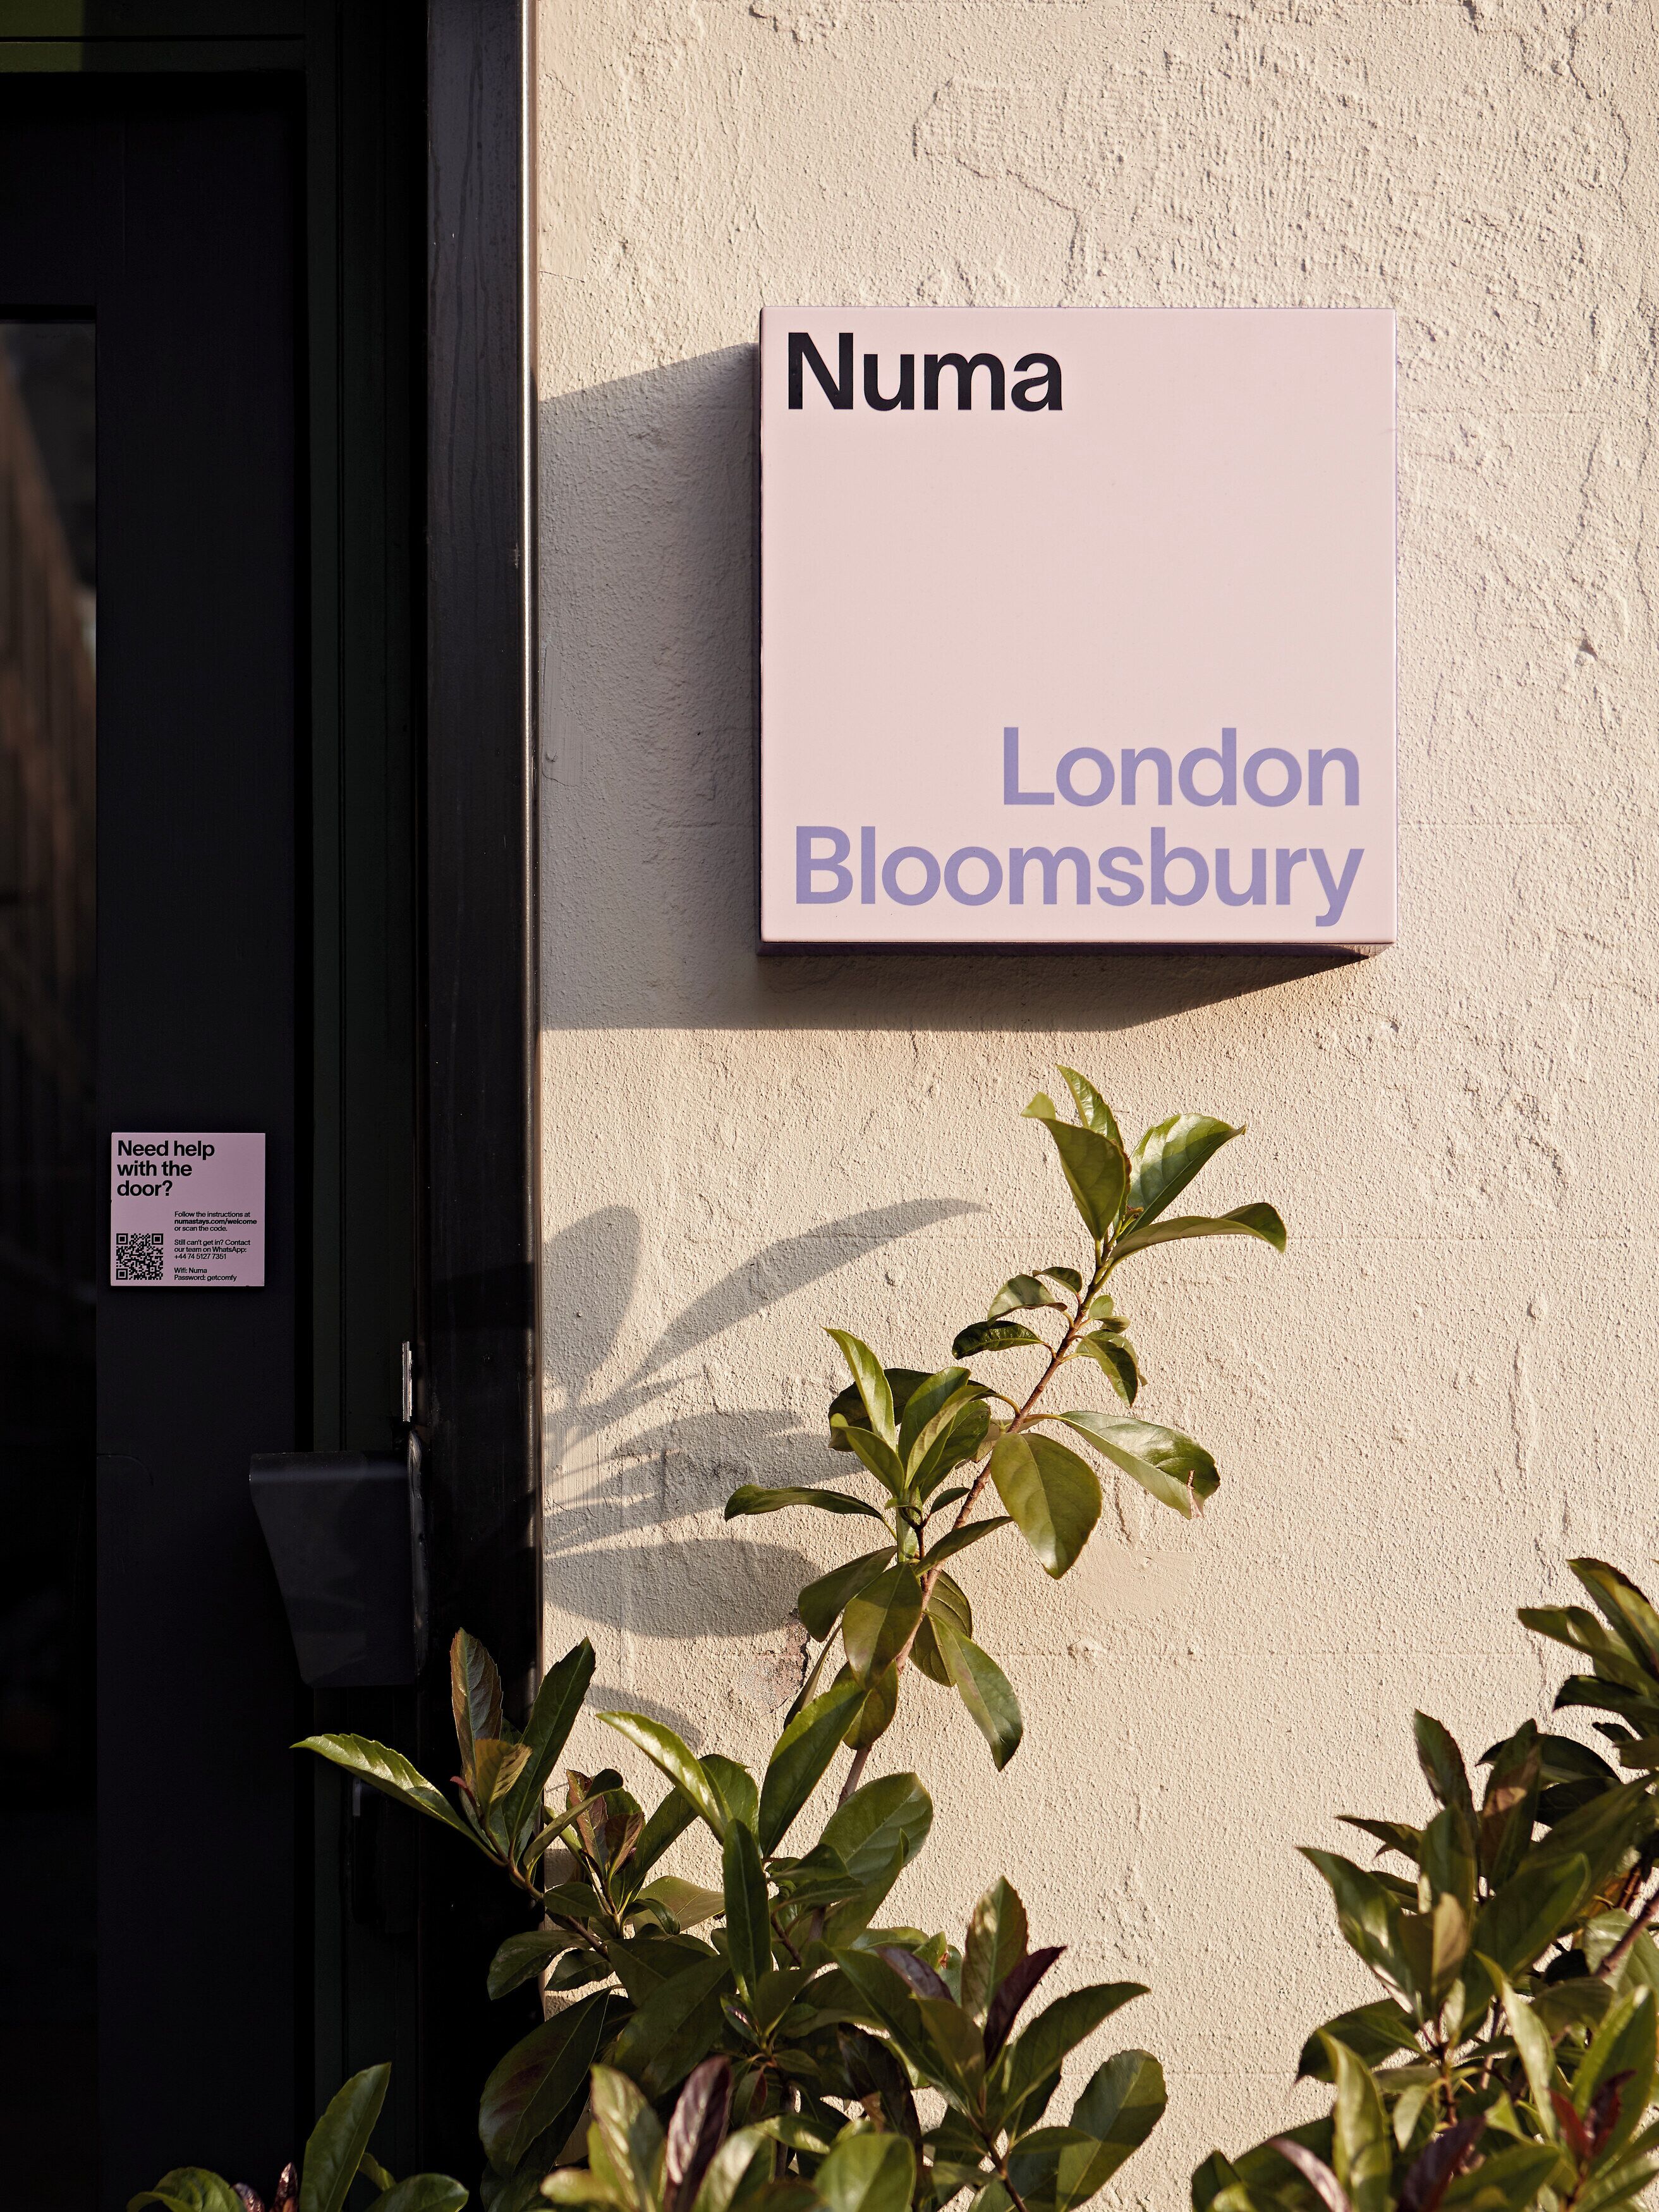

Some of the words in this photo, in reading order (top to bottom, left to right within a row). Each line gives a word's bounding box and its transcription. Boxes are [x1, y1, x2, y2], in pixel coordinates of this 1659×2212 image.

[787, 332, 1063, 411] Numa
[1003, 727, 1360, 806] London
[795, 826, 1364, 927] Bloomsbury
[117, 1160, 157, 1176] with
[162, 1160, 192, 1176] the
[118, 1140, 169, 1157] Need
[174, 1140, 215, 1160] help
[117, 1180, 173, 1196] door?
